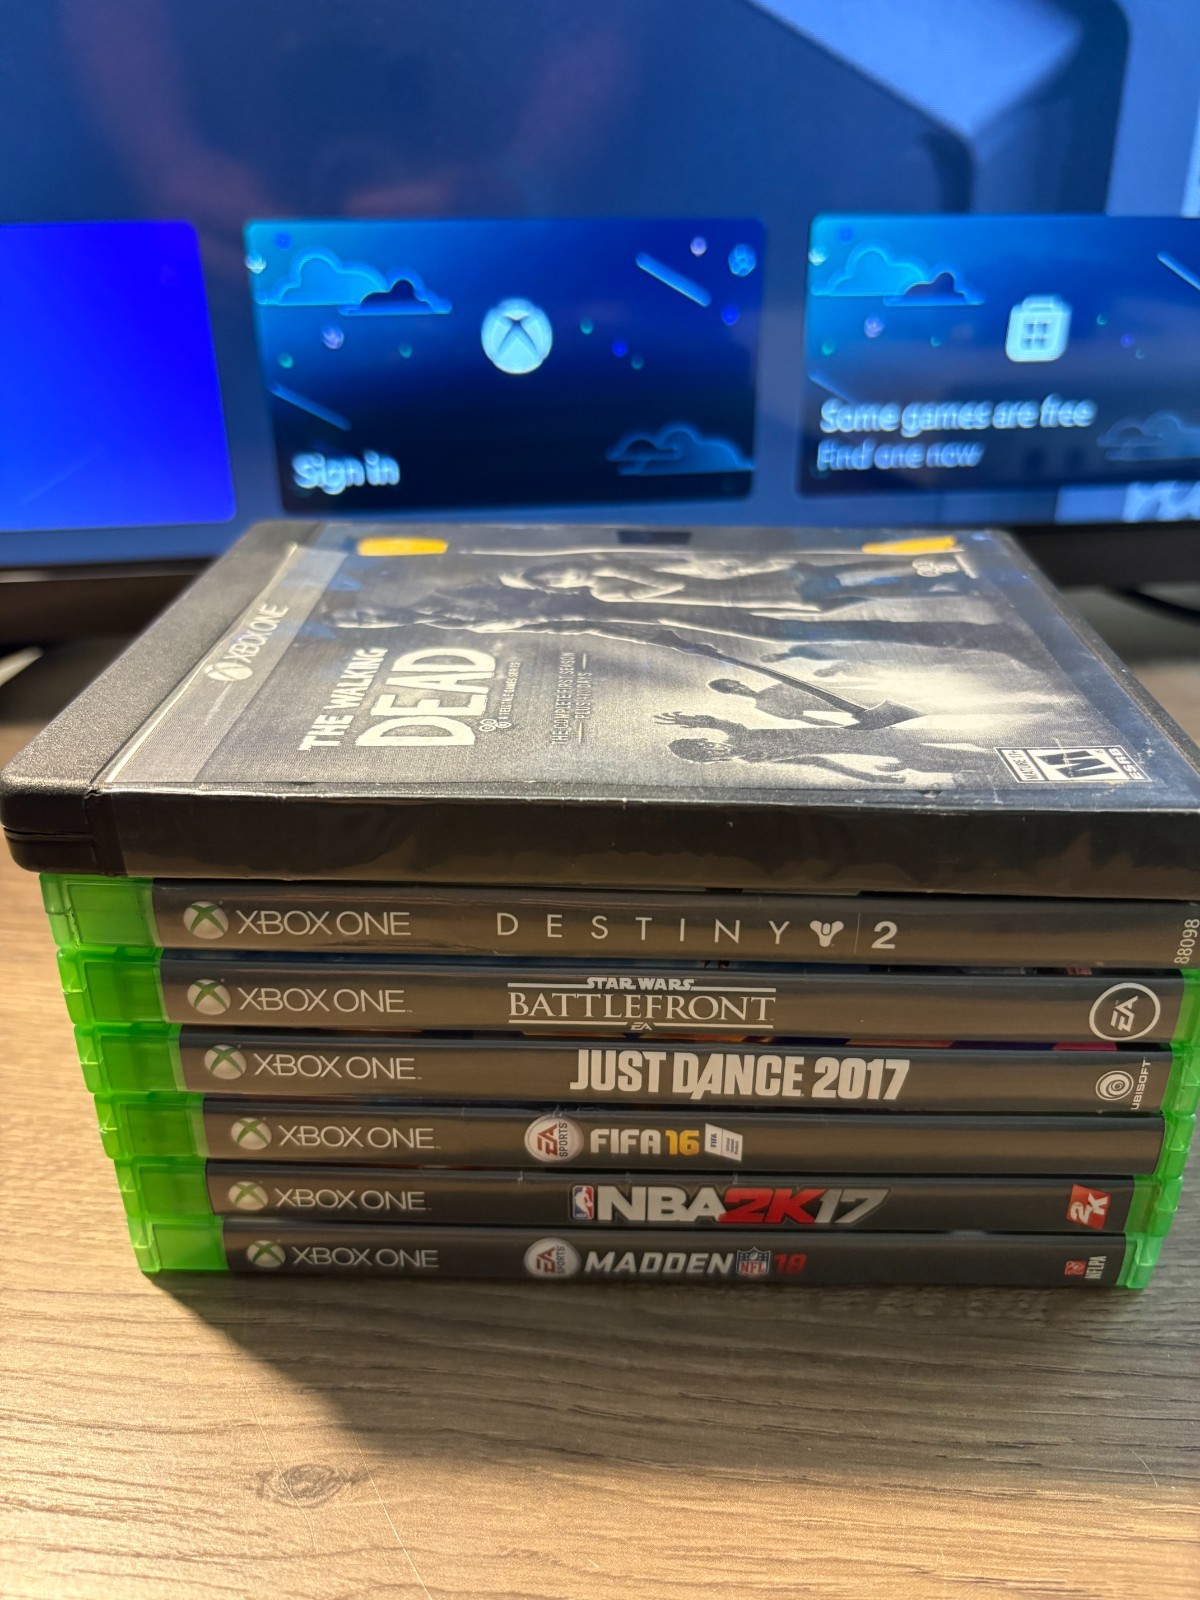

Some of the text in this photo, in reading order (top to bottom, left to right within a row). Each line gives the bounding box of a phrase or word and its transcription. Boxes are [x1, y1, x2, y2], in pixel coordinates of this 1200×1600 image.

[820, 393, 1098, 437] Some games are free
[817, 438, 986, 471] Find one now
[292, 448, 400, 496] Sign in
[223, 602, 289, 664] XBOX ONE
[578, 672, 593, 688] DAYS
[297, 646, 389, 751] THE WALKING
[354, 647, 497, 748] DEAD
[551, 651, 576, 745] THE COMPLETE FIRST SEASON
[574, 702, 591, 719] PLUS
[1012, 758, 1040, 780] MATURE
[1036, 750, 1118, 779] M
[1108, 748, 1144, 780] ESRB
[236, 909, 412, 936] XBOX ONE
[496, 911, 899, 949] DESTINY 2
[1173, 918, 1200, 965] 88098
[586, 976, 695, 991] STAR WARS
[237, 987, 406, 1013] XBOX ONE
[508, 991, 776, 1022] BATTLEFRONT
[1110, 995, 1139, 1032] EA
[630, 1021, 654, 1031] EA
[253, 1053, 417, 1080] XBOX ONE
[569, 1049, 910, 1100] JUST DANCE 2017
[1129, 1059, 1151, 1110] UBISOFT
[278, 1124, 435, 1149] XBOX ONE
[537, 1122, 559, 1156] EA
[558, 1121, 569, 1158] SPORTS
[590, 1128, 661, 1155] FIFA
[665, 1129, 700, 1156] 16
[710, 1133, 718, 1148] FIFA
[274, 1188, 427, 1211] XBOX ONE
[1070, 1191, 1109, 1225] 2K
[292, 1246, 440, 1268] XBOX ONE
[535, 1246, 556, 1274] EA
[556, 1245, 566, 1275] SPORTS
[583, 1251, 807, 1275] MADDEN NFL 18
[1084, 1255, 1107, 1279] NFLPA
